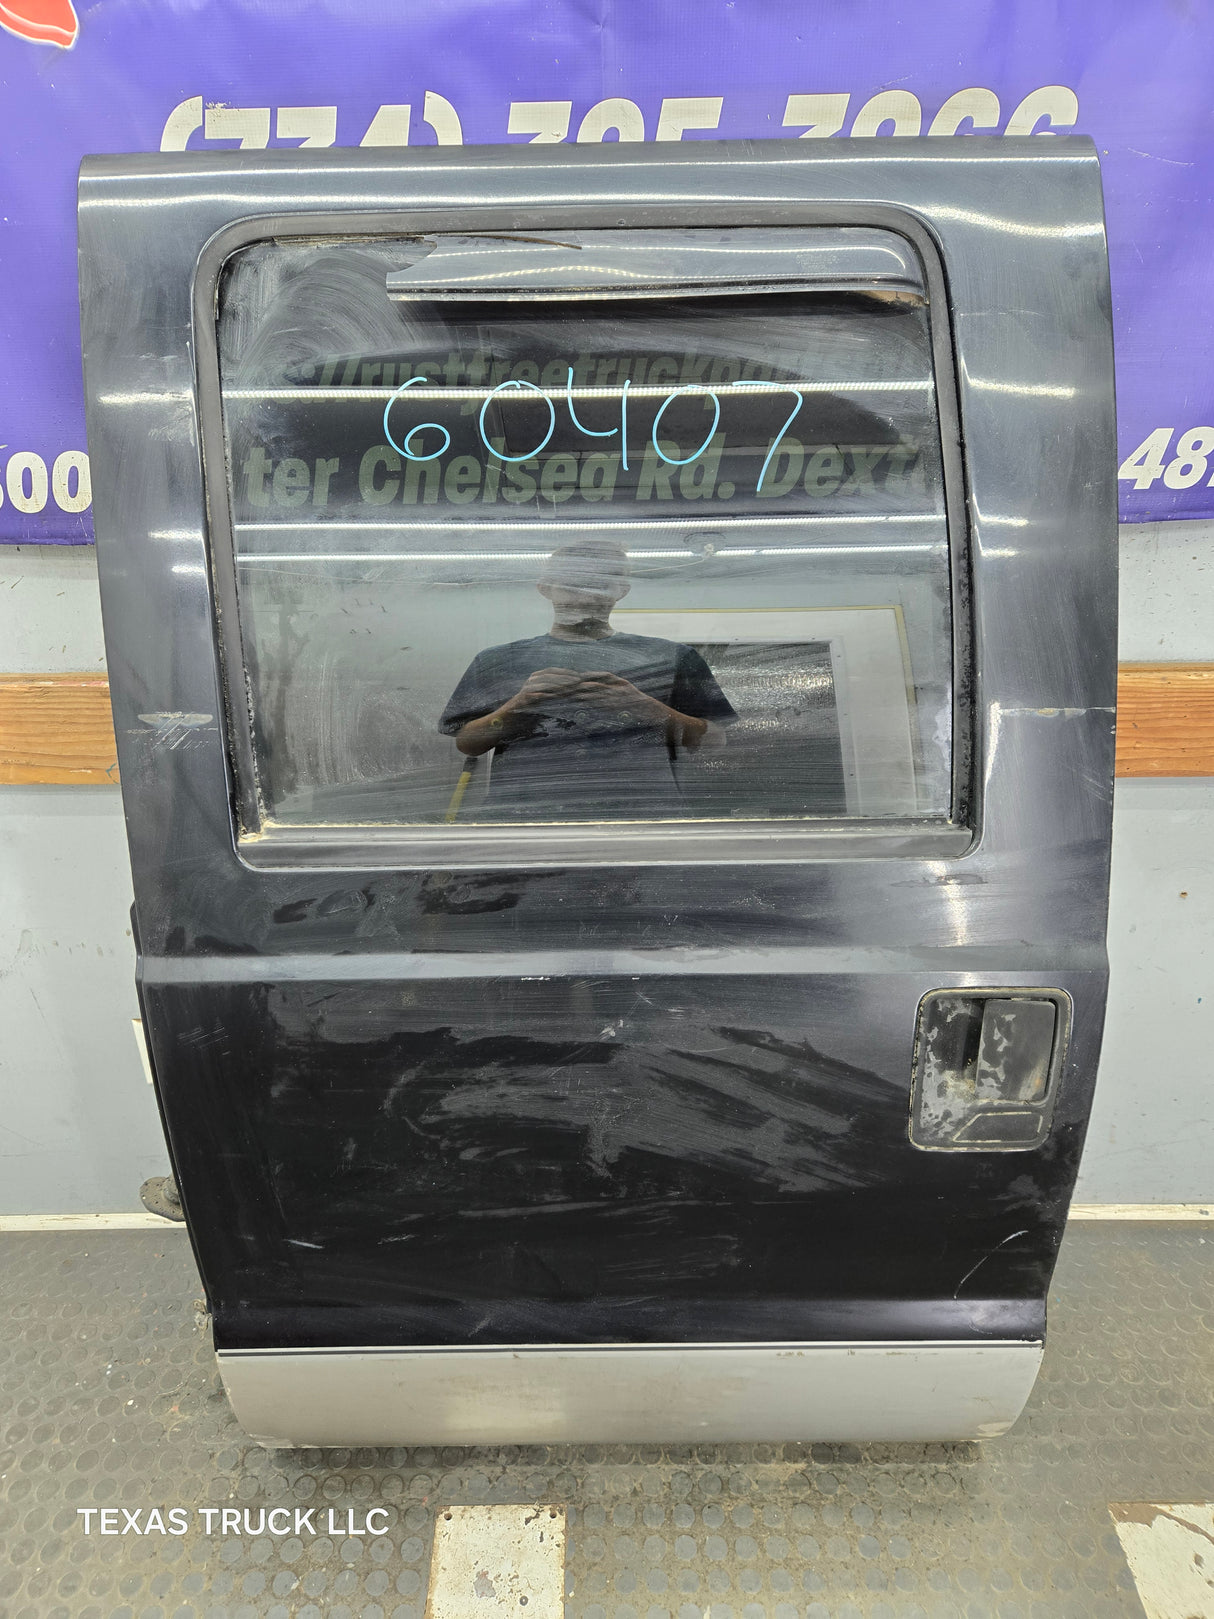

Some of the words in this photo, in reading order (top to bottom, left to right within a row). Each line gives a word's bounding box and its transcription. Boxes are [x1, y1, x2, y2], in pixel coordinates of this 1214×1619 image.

[0, 450, 93, 513] 00
[358, 437, 621, 505] Chelsea
[636, 432, 736, 500] Rd.
[1117, 426, 1214, 490] 48
[383, 366, 803, 492] 60407
